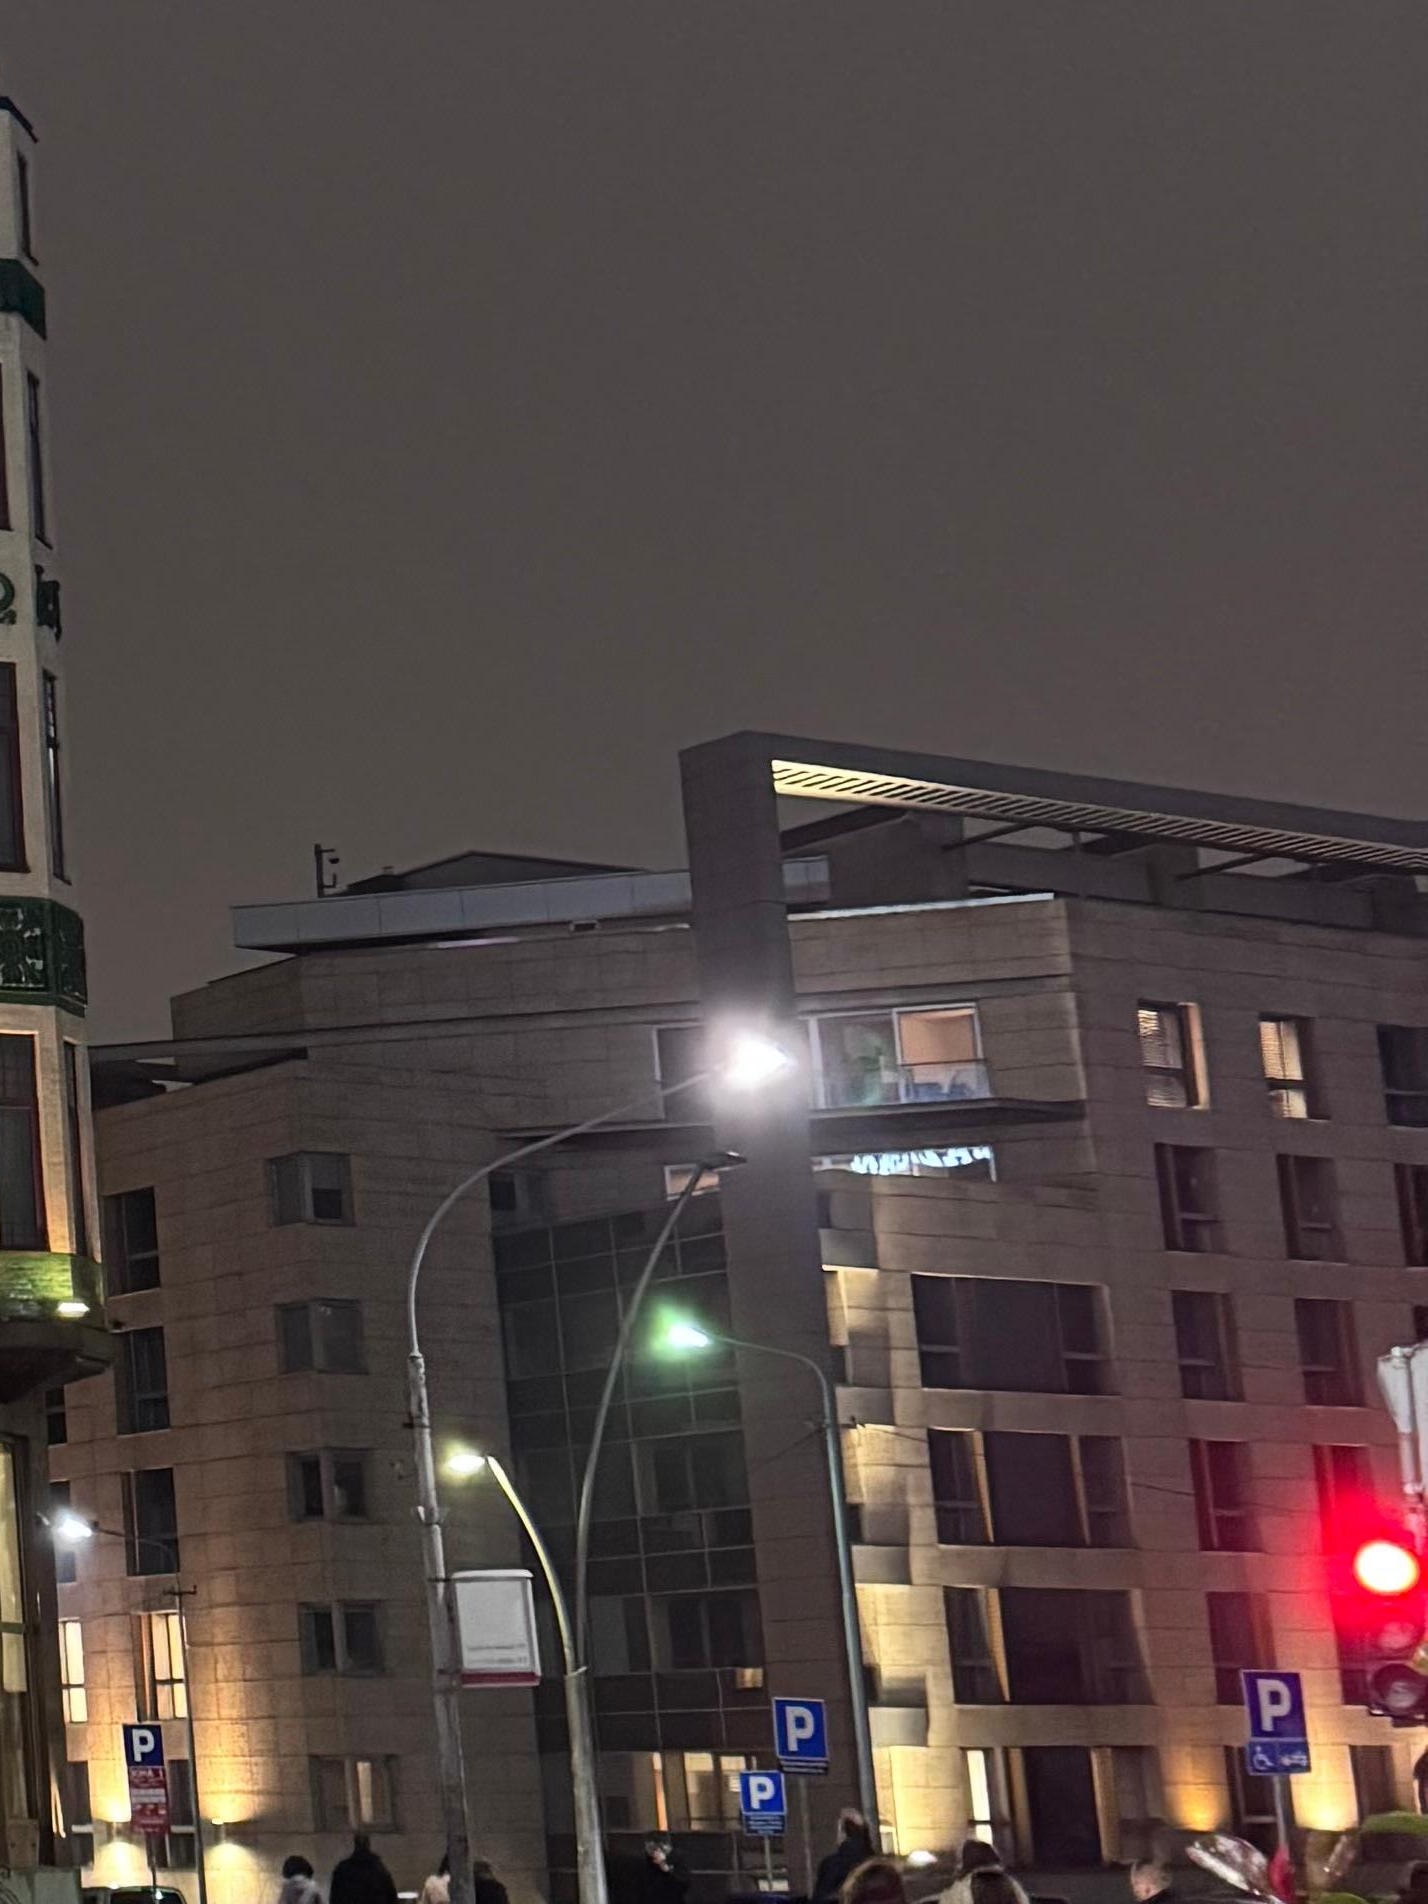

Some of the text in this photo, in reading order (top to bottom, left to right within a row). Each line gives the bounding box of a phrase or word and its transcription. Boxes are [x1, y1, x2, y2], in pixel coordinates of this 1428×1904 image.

[1256, 1678, 1292, 1732] P
[131, 1728, 155, 1762] P
[785, 1705, 815, 1752] P
[748, 1775, 776, 1809] P
